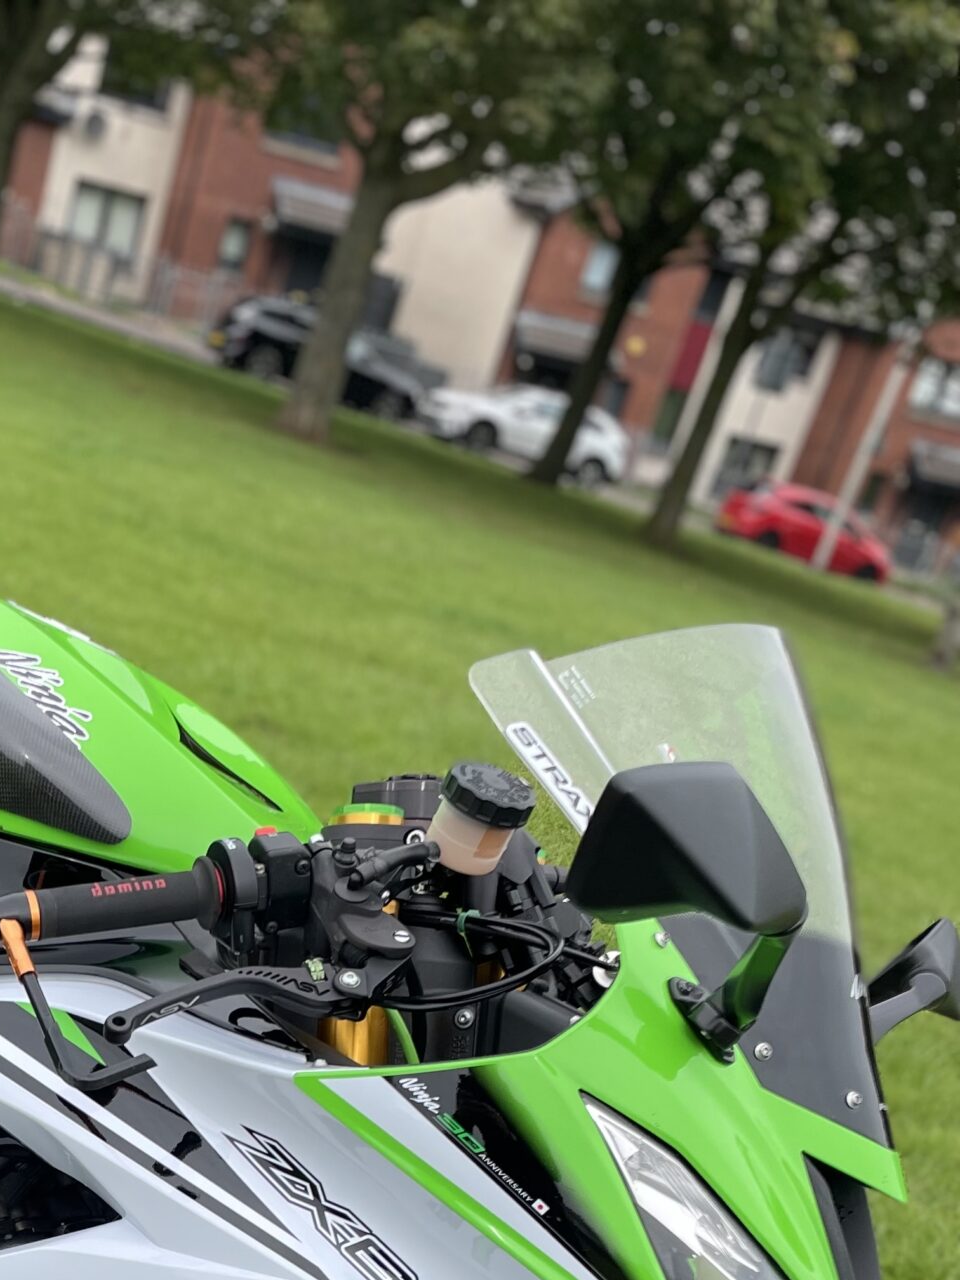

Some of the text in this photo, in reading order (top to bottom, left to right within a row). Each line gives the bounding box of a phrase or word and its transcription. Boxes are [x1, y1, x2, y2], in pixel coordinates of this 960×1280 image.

[90, 877, 167, 897] domino
[399, 1077, 441, 1115] Ninja
[478, 1152, 534, 1203] ANNIVERSARY
